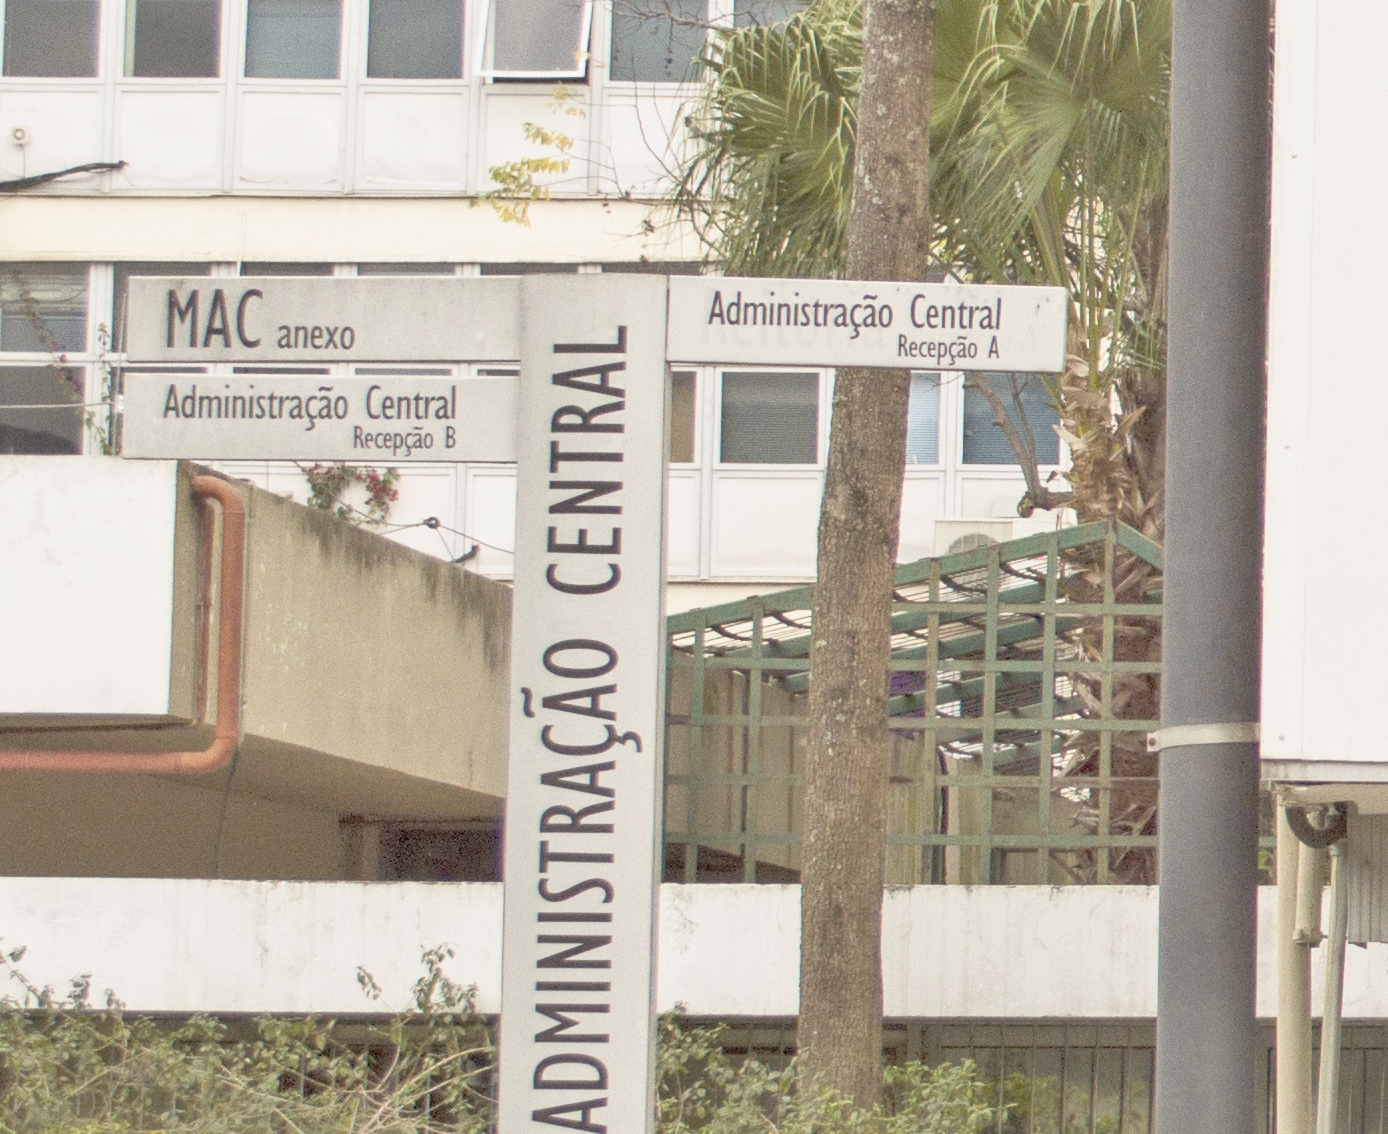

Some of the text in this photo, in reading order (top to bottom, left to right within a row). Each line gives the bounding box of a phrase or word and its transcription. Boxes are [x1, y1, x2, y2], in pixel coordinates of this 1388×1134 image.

[165, 288, 355, 350] MAC anexo
[708, 290, 893, 339] Administração
[910, 294, 1002, 330] Central
[898, 333, 978, 365] Recepção
[987, 336, 1000, 359] A
[163, 384, 456, 431] Administração Central
[353, 425, 456, 456] Recepção B
[519, 325, 642, 1134] ADMINISTRAÇÃO CENTRAL
